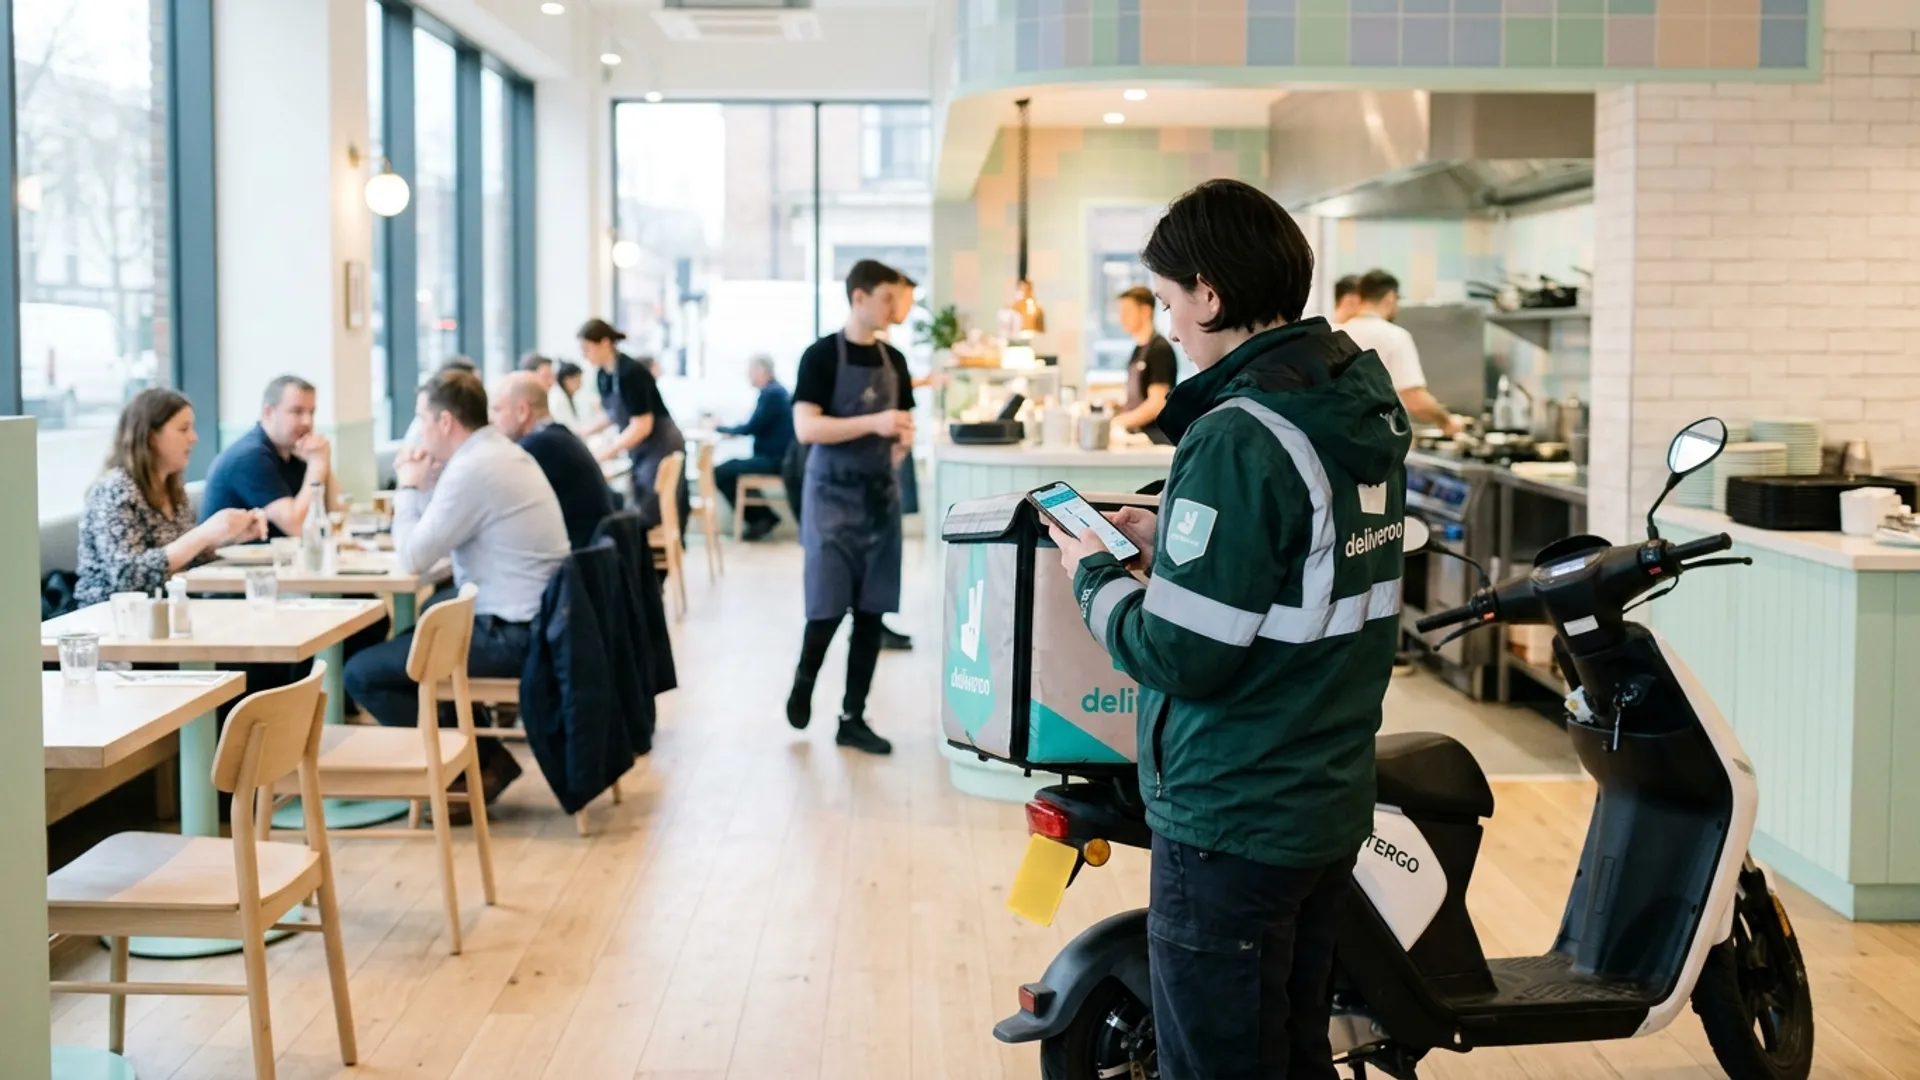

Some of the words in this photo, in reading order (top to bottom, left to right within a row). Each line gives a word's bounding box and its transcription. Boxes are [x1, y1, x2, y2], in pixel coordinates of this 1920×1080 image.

[1345, 521, 1403, 558] deliveroo
[1081, 687, 1134, 714] deli
[1365, 834, 1420, 874] TERGO
